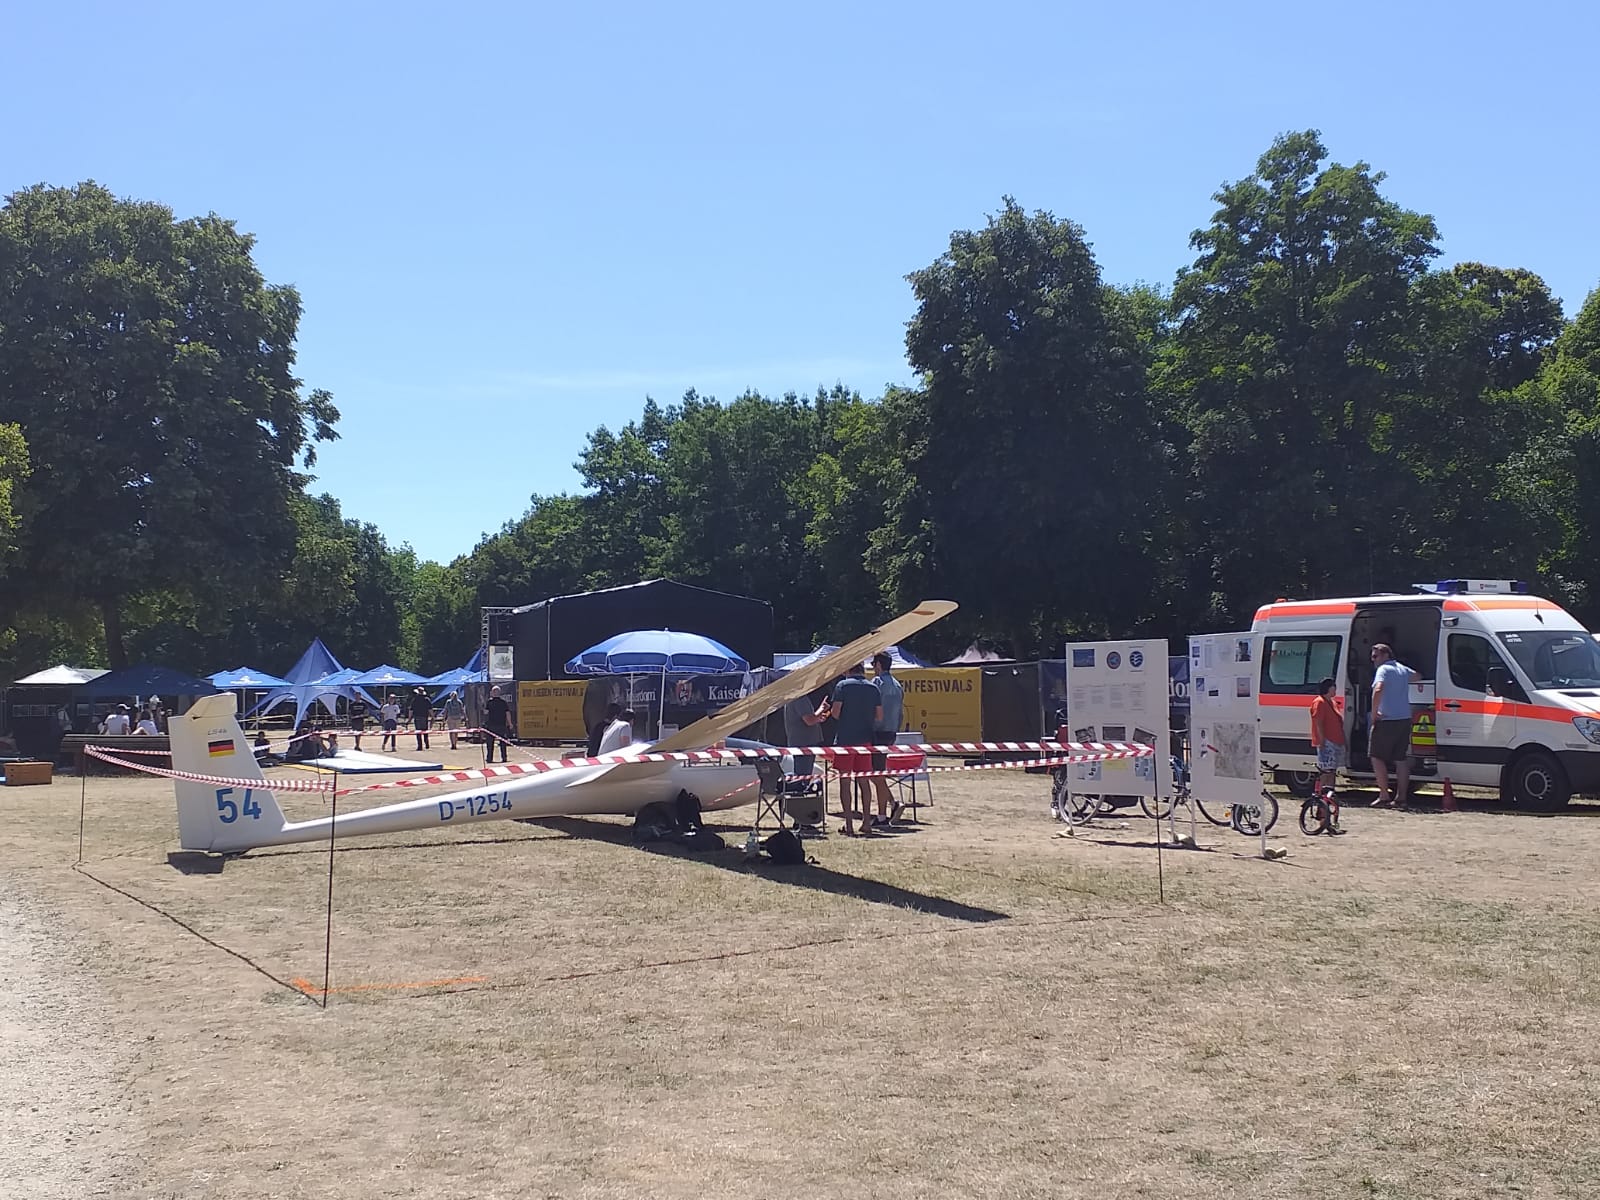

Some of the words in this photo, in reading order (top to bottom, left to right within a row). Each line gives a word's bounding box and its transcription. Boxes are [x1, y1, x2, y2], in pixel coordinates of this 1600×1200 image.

[708, 685, 743, 701] Kaise
[914, 679, 973, 693] FESTIVALS
[216, 787, 262, 824] 54
[438, 791, 513, 821] D-1254
